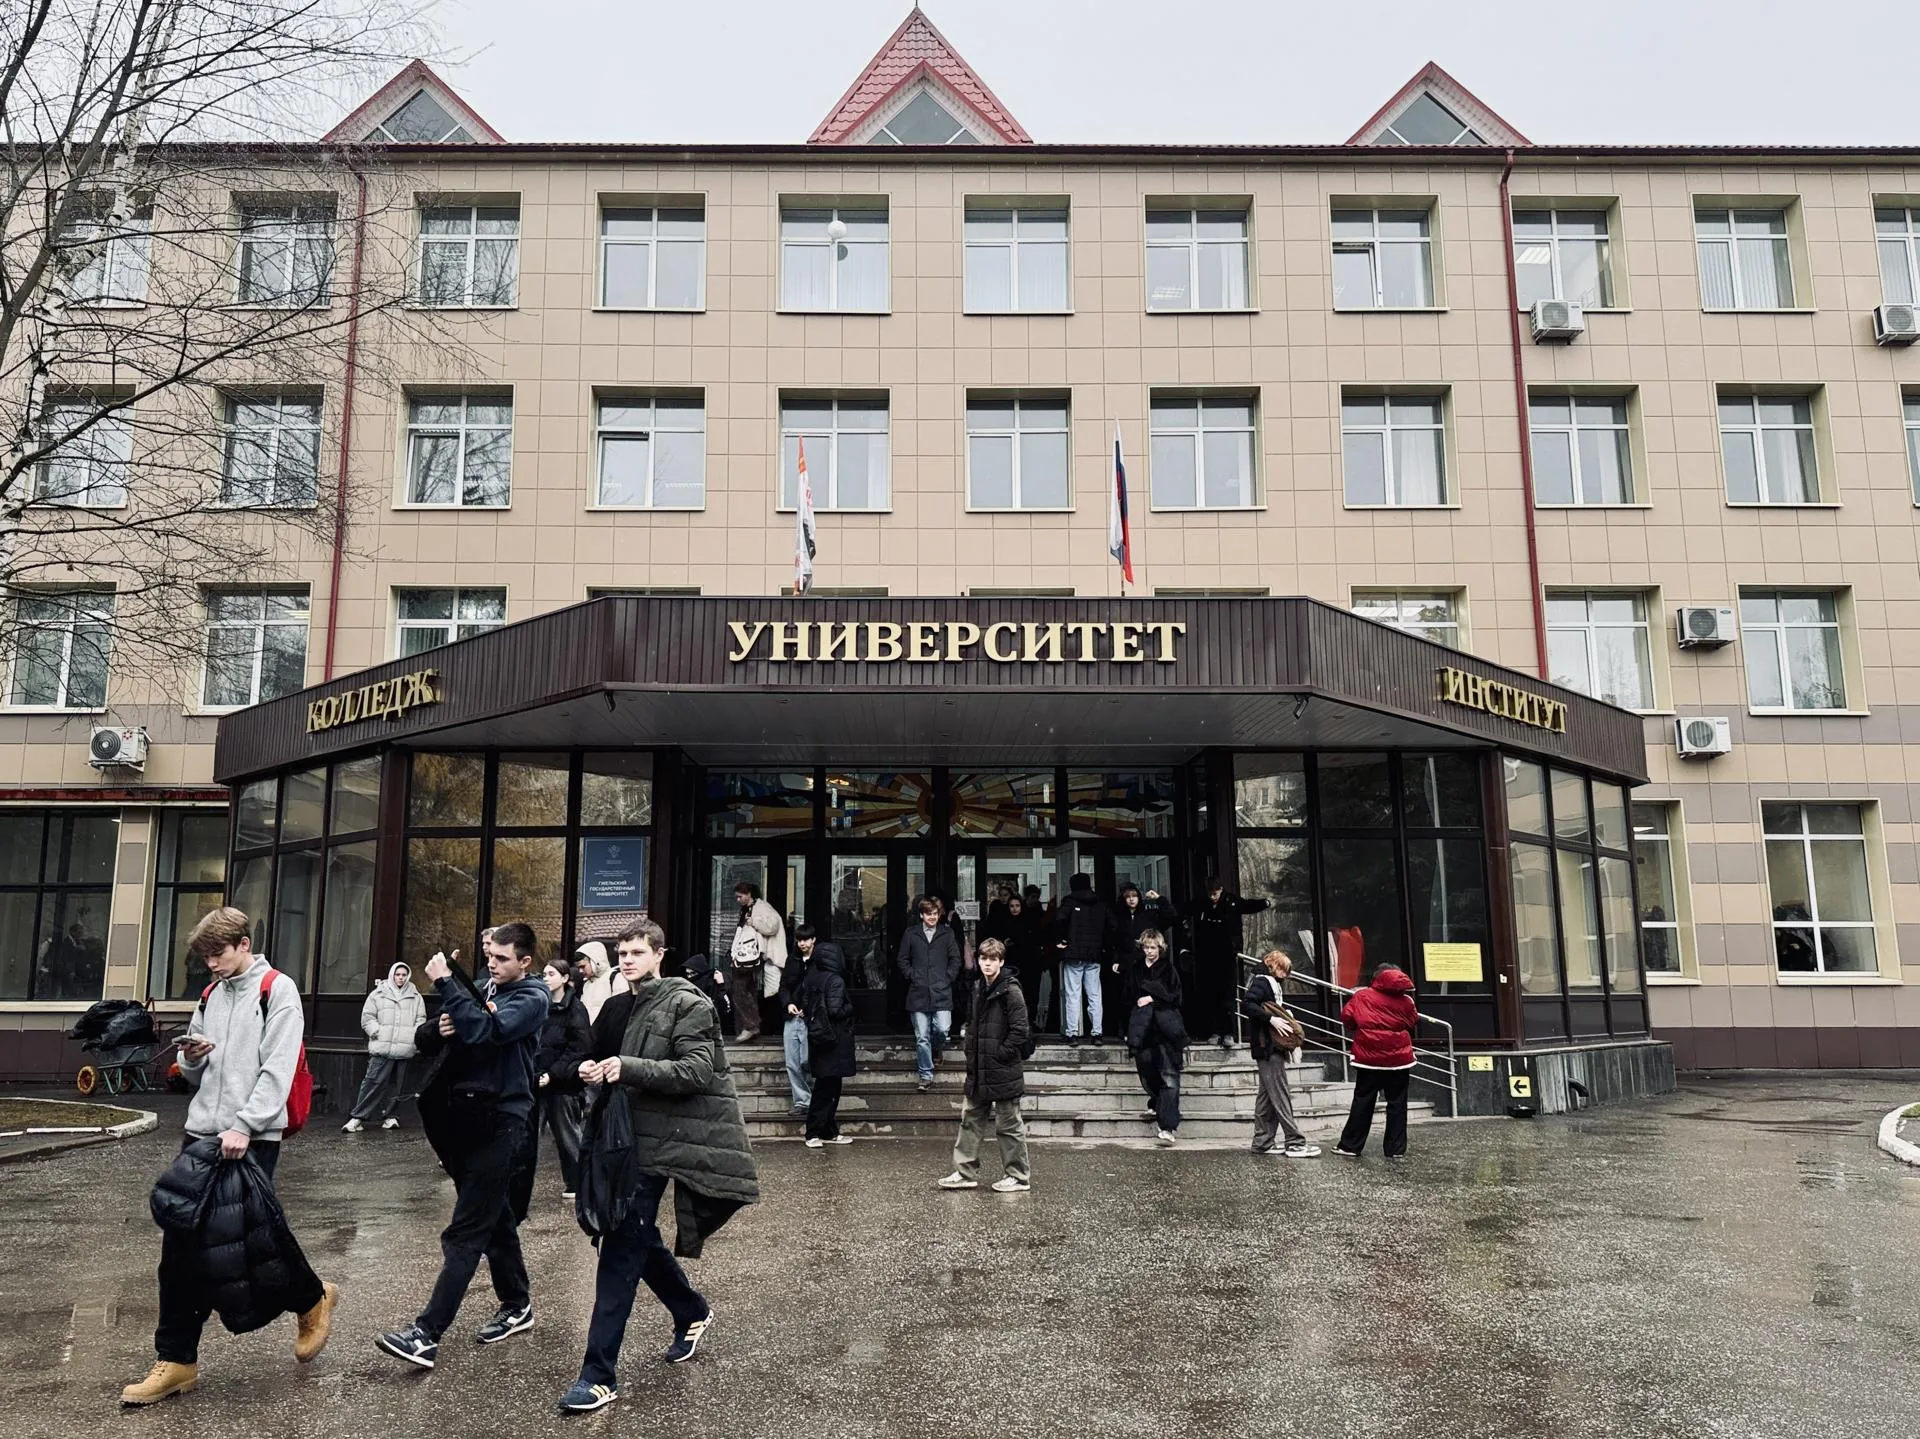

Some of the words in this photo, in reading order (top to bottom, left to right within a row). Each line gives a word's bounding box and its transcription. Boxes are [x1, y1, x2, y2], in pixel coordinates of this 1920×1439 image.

[728, 621, 1186, 664] УНИВЕРСИТЕТ
[305, 668, 438, 734] КОЛЛЕДЖ
[1440, 666, 1568, 734] ИНСТИТУТ
